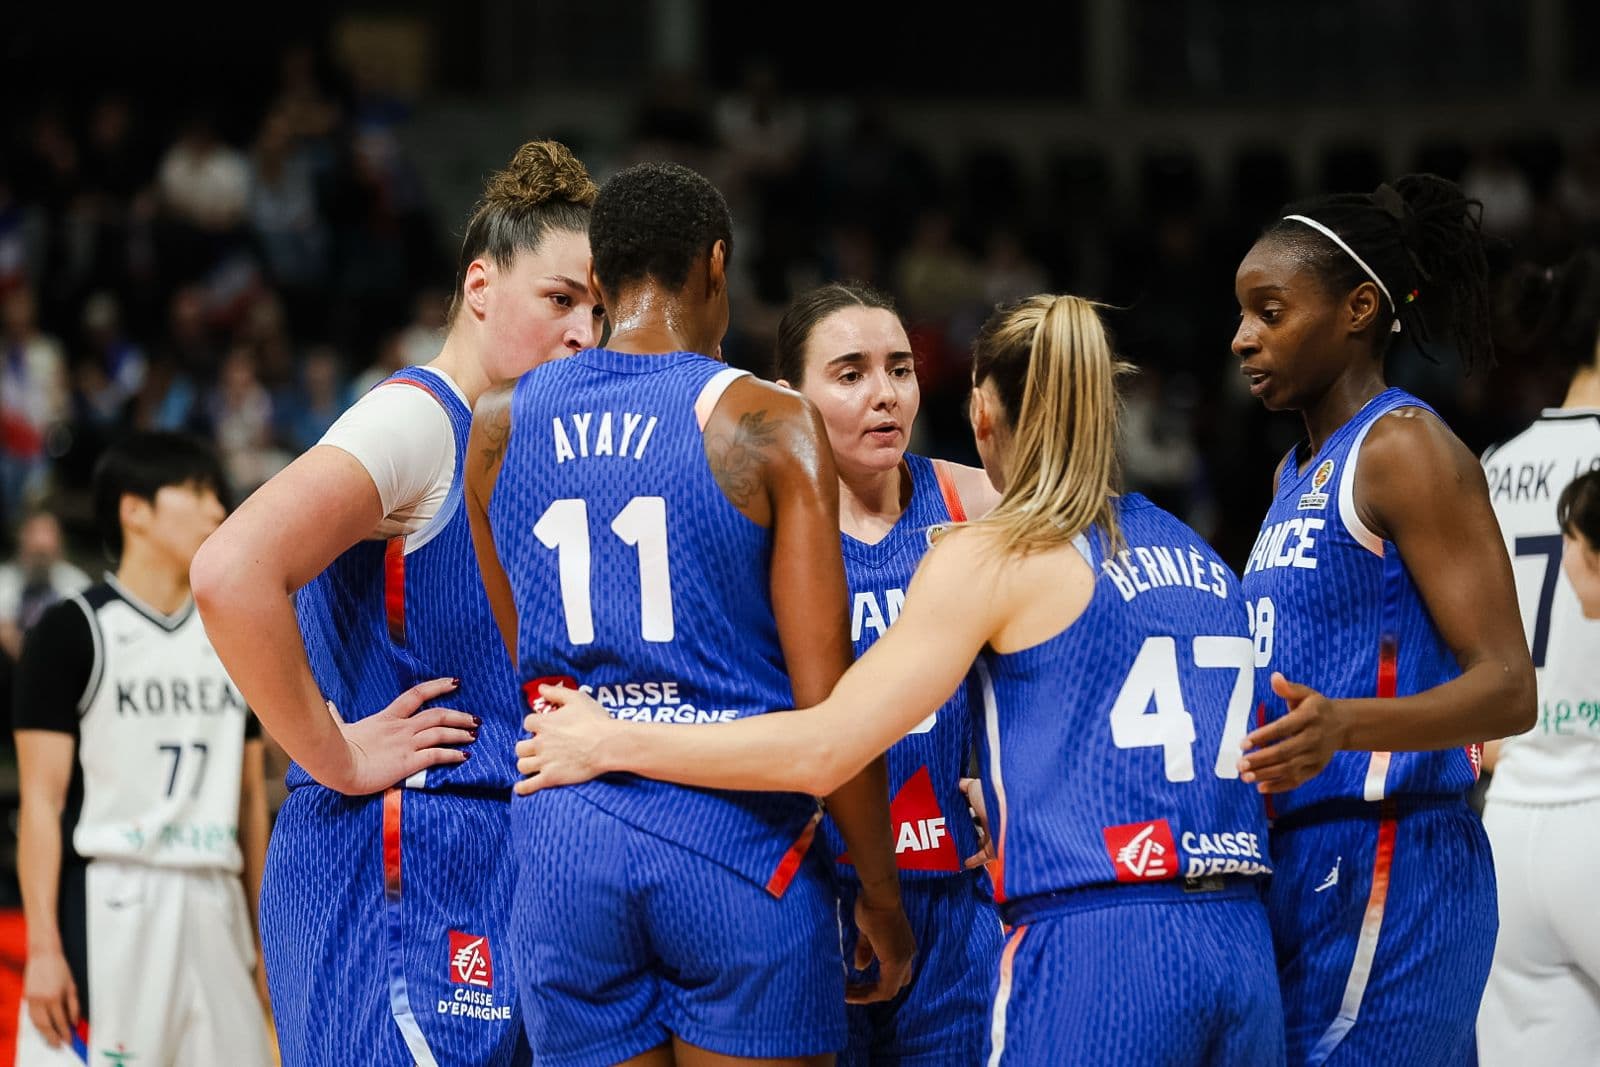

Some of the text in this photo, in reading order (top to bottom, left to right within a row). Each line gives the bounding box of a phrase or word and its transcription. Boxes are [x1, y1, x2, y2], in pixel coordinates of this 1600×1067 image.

[552, 412, 658, 463] AYAYI
[532, 496, 675, 645] 11
[1244, 517, 1326, 576] ANCE
[1102, 544, 1228, 602] BERNIÈS
[116, 677, 241, 716] KOREA
[1109, 636, 1256, 783] 47
[158, 741, 209, 800] 77
[893, 817, 946, 854] AIF
[1181, 831, 1262, 859] CAISSE
[437, 999, 511, 1021] D'EPARGNE
[454, 988, 493, 1007] CAISSE
